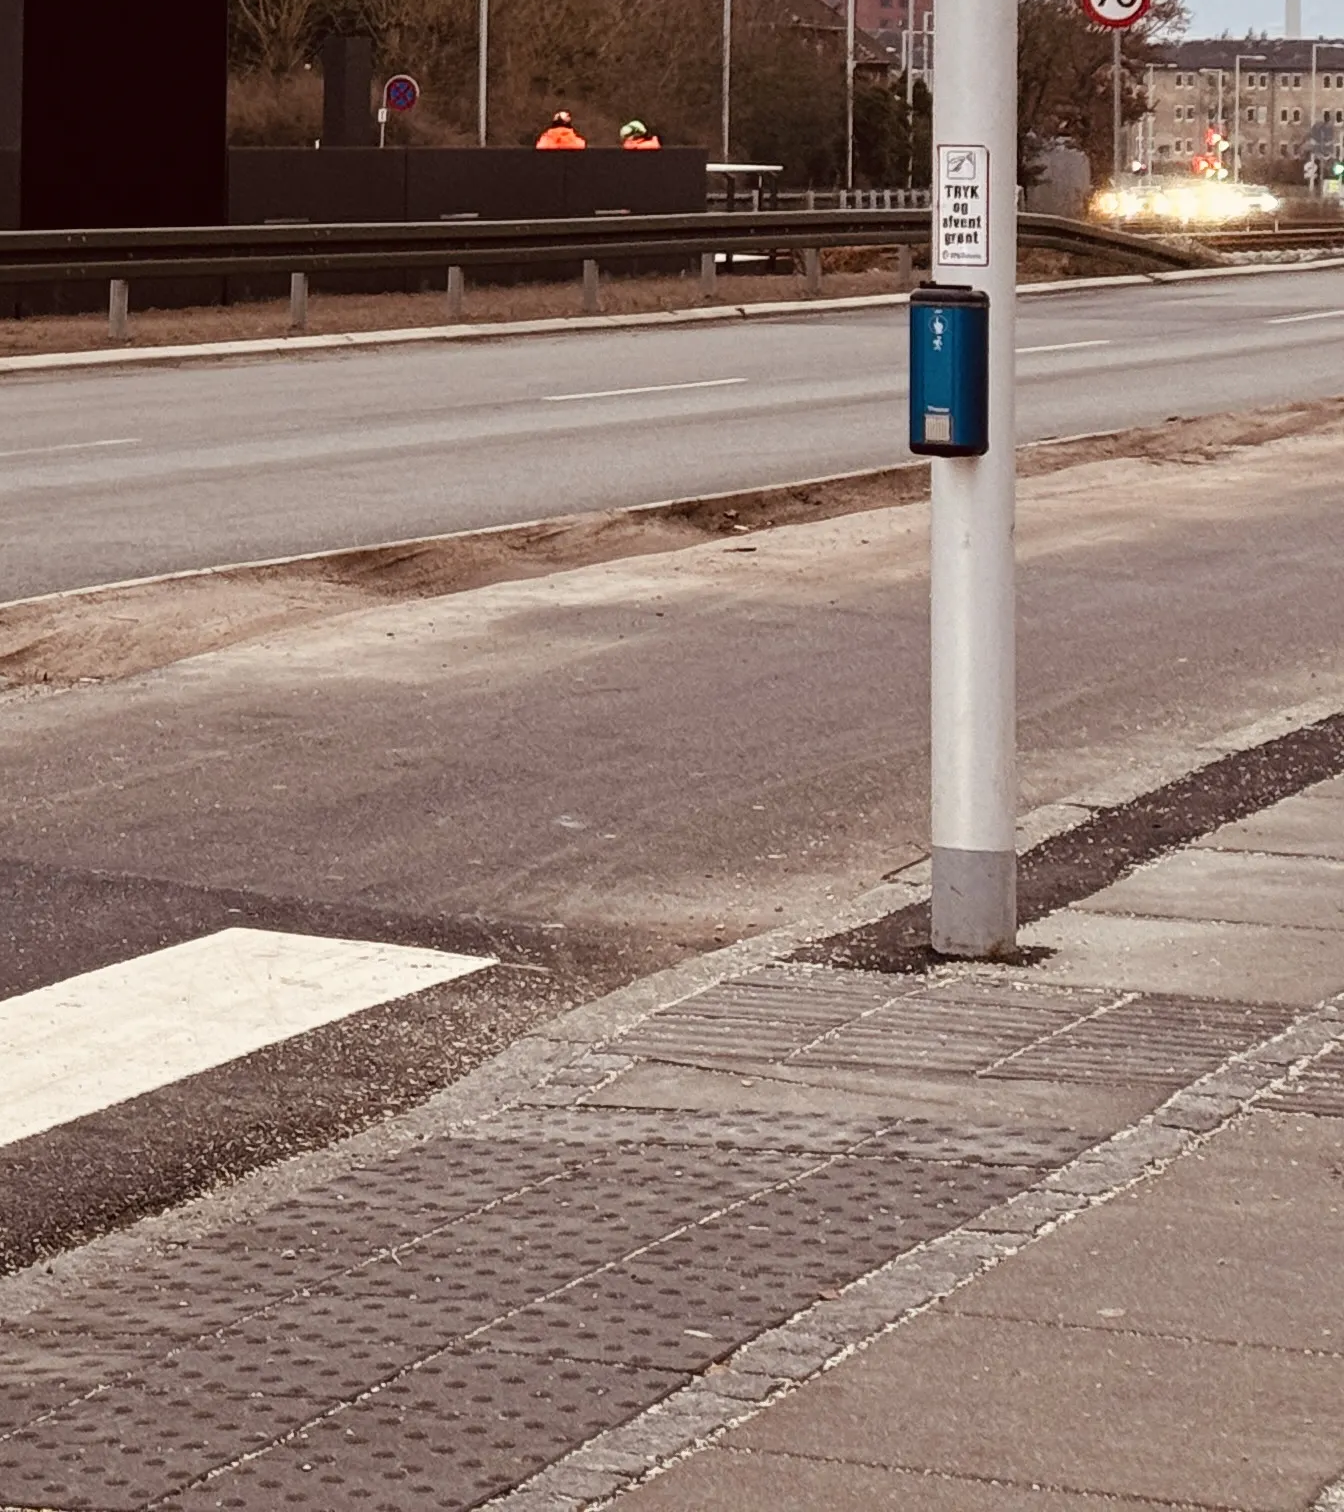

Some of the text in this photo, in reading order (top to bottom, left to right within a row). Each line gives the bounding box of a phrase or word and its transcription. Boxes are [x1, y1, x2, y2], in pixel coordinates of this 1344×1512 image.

[944, 185, 979, 199] TRYK
[953, 203, 968, 215] og
[942, 216, 981, 229] afvent
[944, 231, 979, 245] grønt
